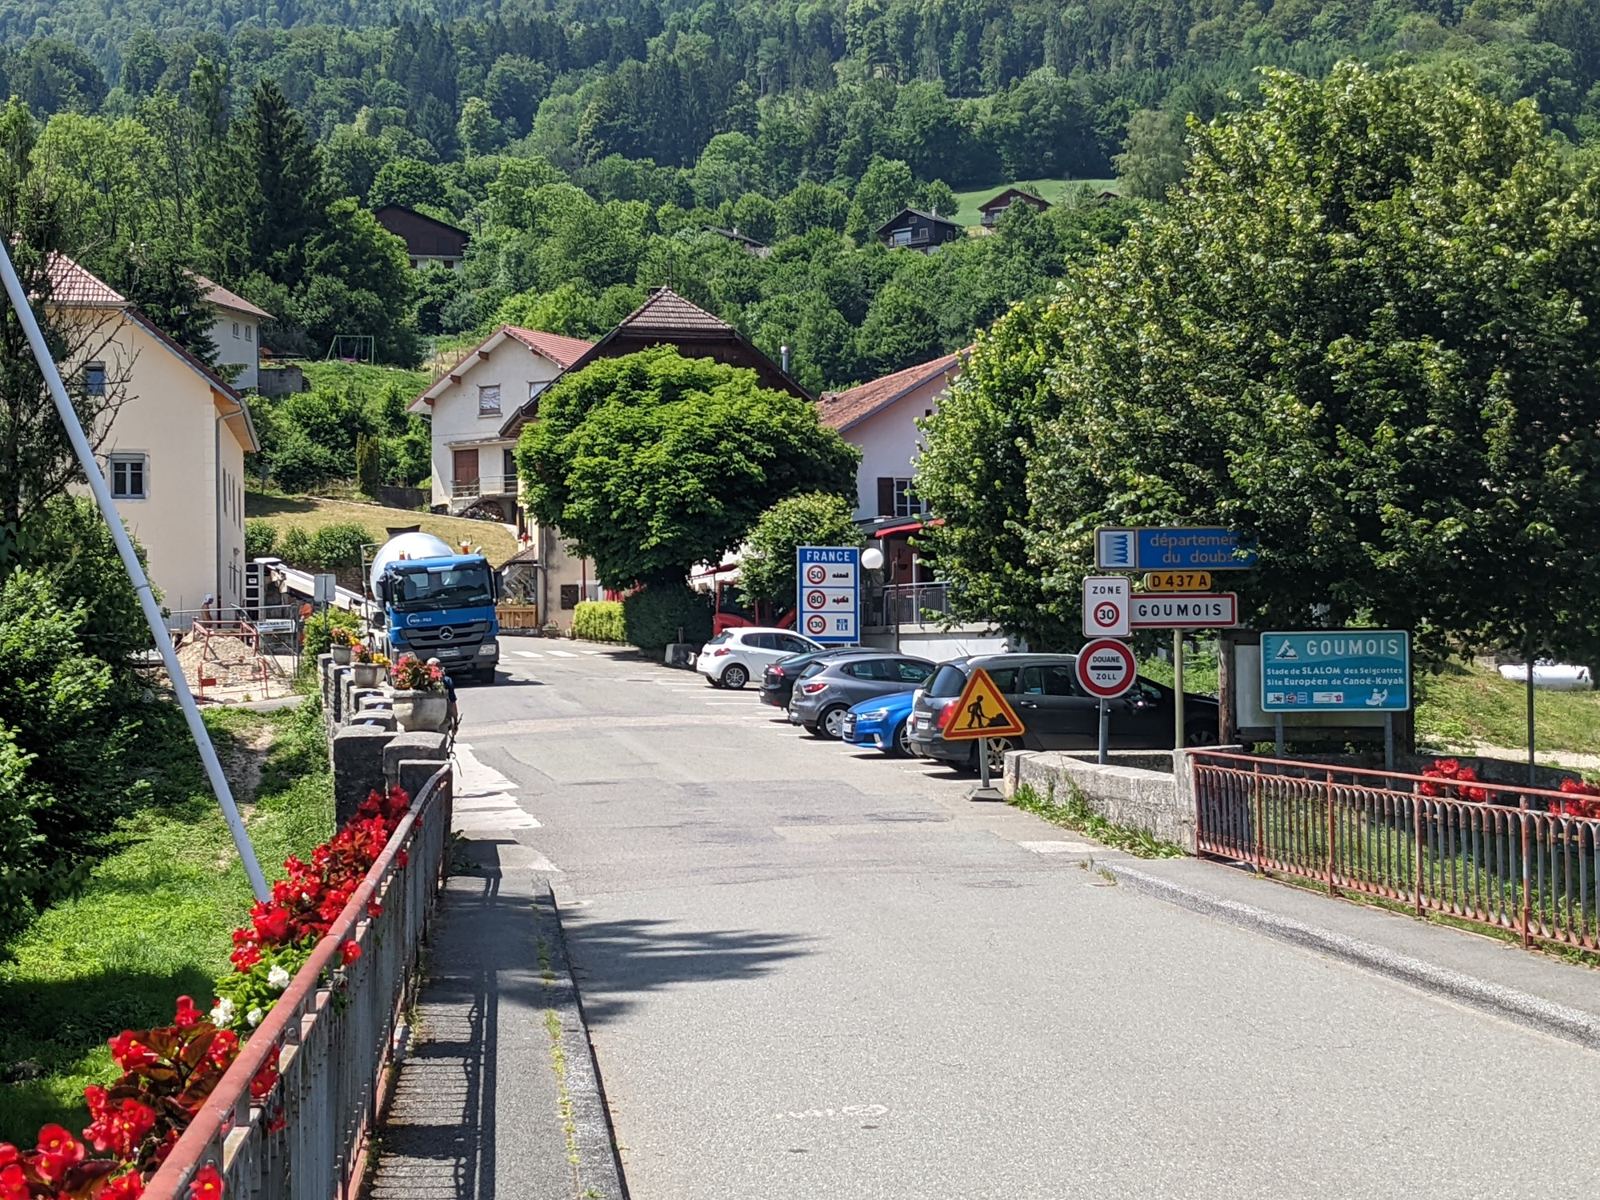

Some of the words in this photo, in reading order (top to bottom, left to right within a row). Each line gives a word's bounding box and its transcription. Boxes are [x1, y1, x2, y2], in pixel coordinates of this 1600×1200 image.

[806, 551, 850, 561] FRANCE
[1162, 551, 1181, 564] du
[810, 571, 822, 580] 50
[1152, 576, 1161, 588] D
[1165, 575, 1194, 588] 437
[1198, 576, 1208, 587] A
[1092, 586, 1122, 595] ZONE
[810, 596, 822, 605] 80
[1099, 609, 1115, 620] 30
[1138, 604, 1222, 616] GOUMOIS
[810, 621, 823, 629] 130
[1306, 639, 1399, 656] GOUMOIS
[1301, 666, 1341, 674] SLALOM
[1283, 677, 1328, 687] Européen
[1342, 677, 1405, 686] Canoë-Kayak
